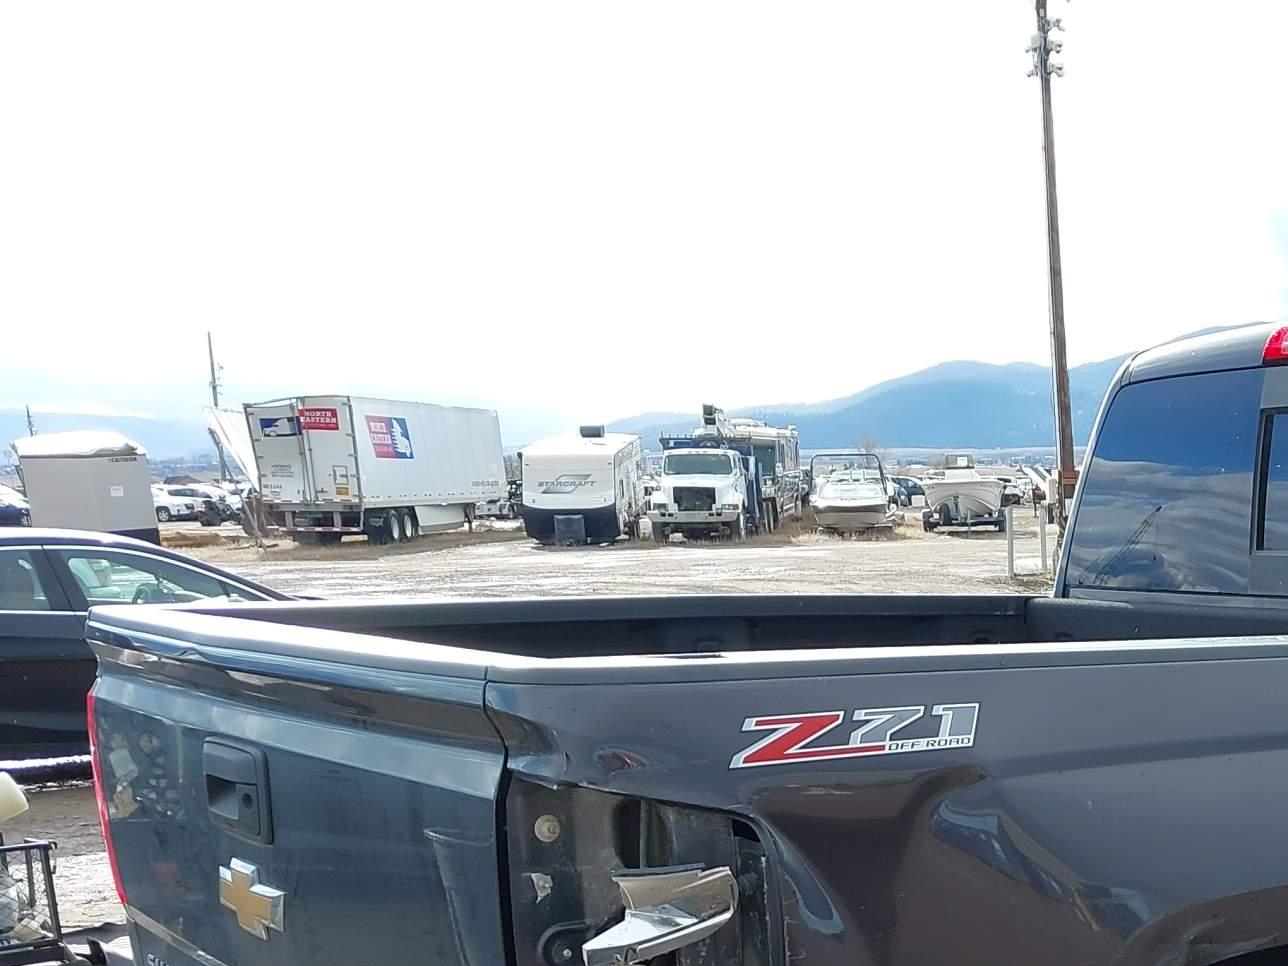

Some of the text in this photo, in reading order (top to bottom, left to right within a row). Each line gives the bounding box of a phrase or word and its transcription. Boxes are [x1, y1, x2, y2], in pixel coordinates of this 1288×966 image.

[537, 480, 597, 488] STARCRAFT
[728, 702, 981, 770] Z71
[888, 736, 972, 751] OFF ROAD
